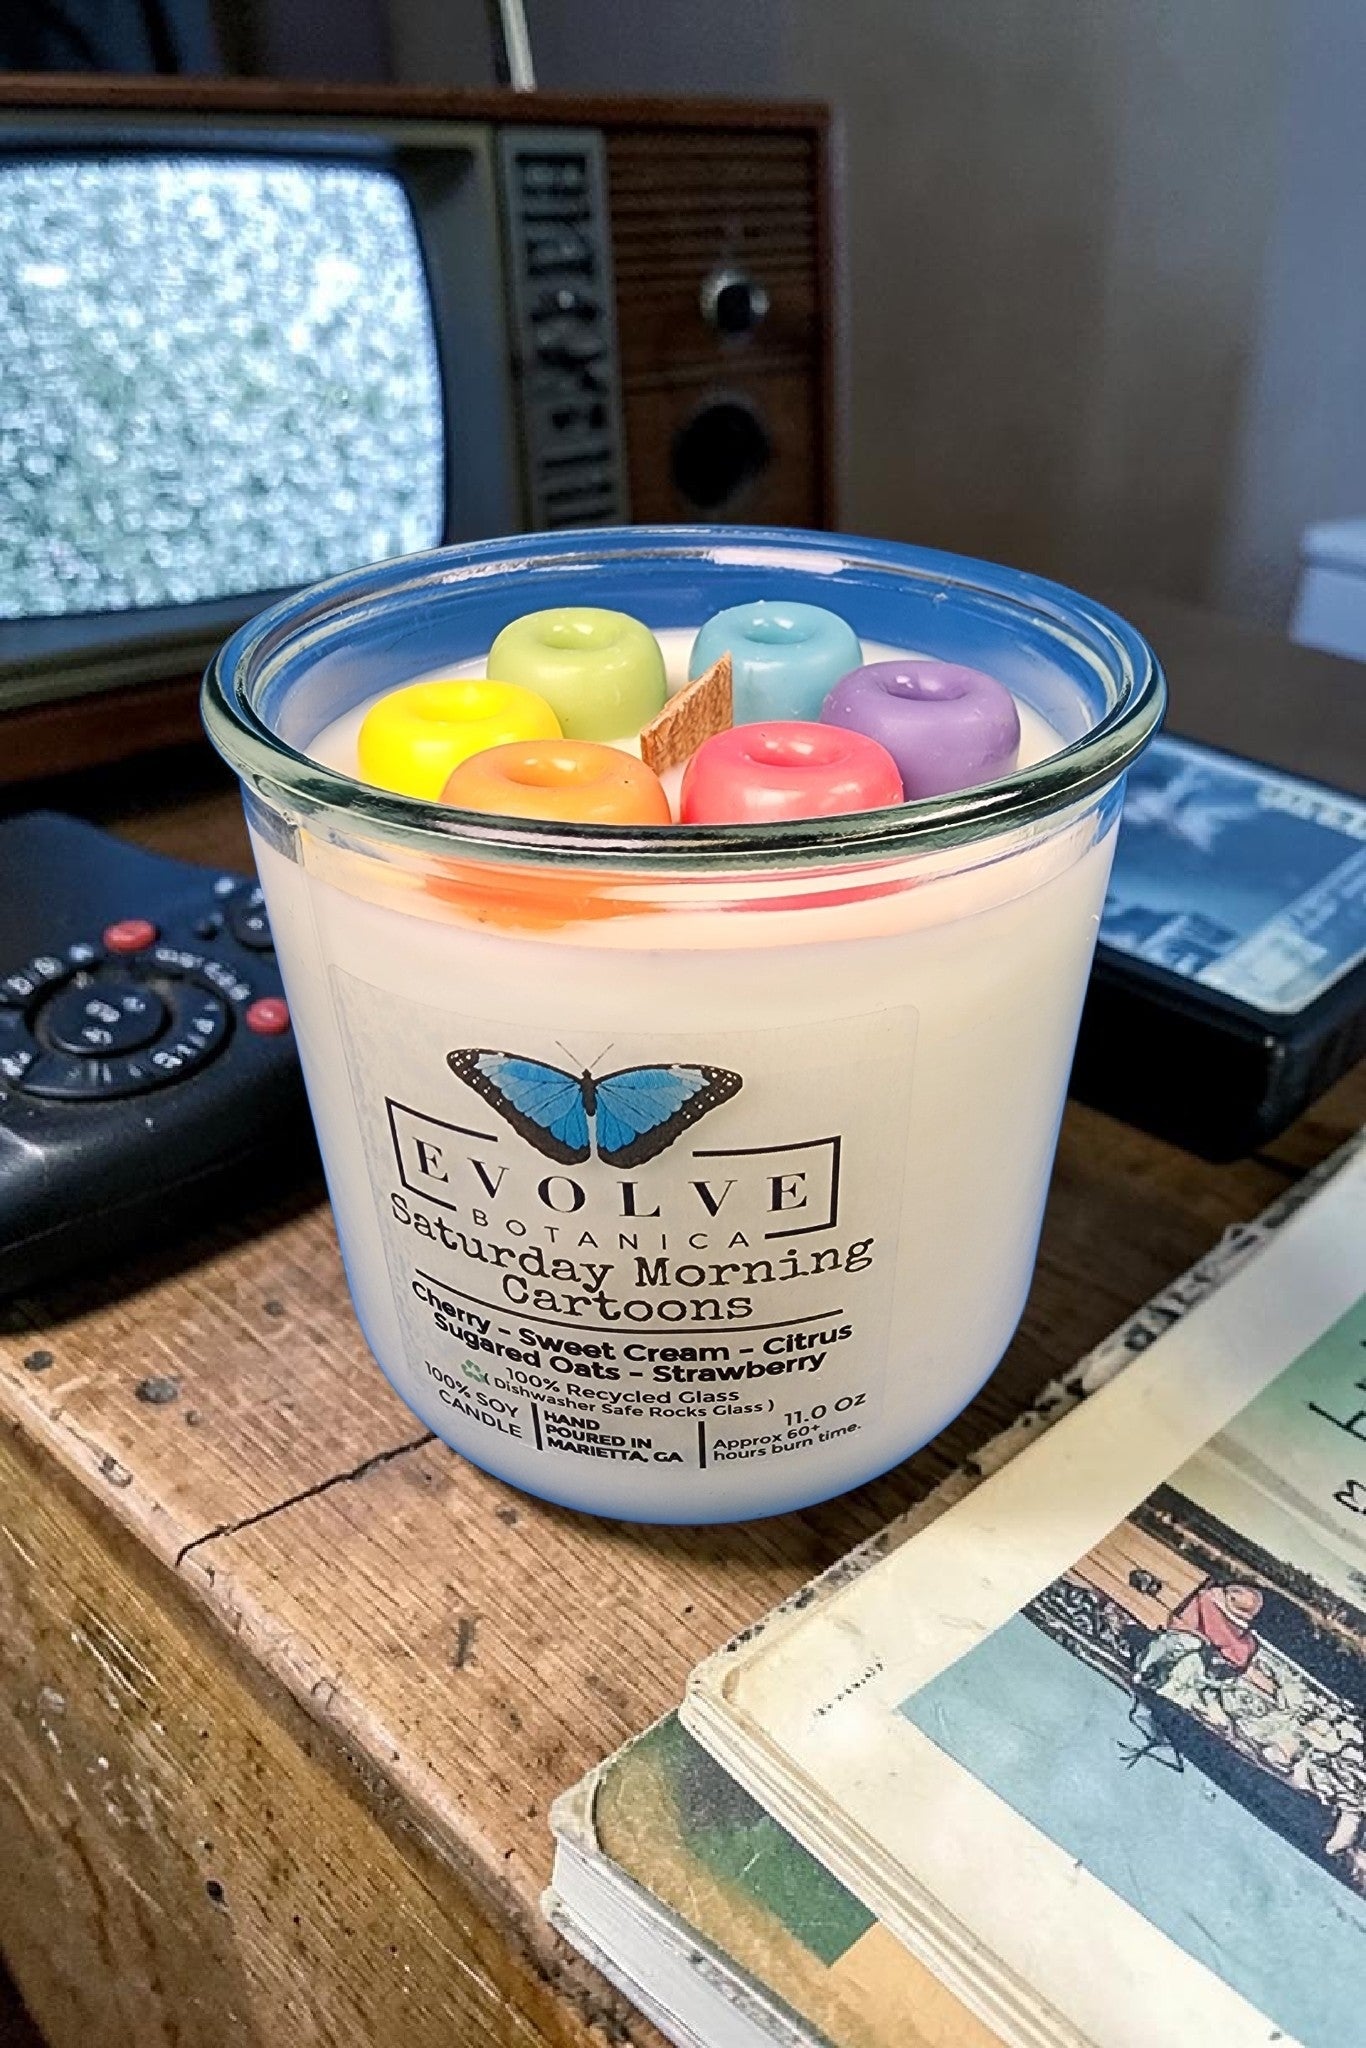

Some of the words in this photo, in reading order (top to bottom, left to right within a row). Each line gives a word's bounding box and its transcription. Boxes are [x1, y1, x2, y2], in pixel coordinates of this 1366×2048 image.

[412, 1136, 808, 1218] EVOLVE
[390, 1192, 615, 1294] Saturday
[633, 1237, 875, 1288] Morning
[472, 1208, 750, 1250] BOTANICA
[502, 1274, 753, 1322] Cartoons
[411, 1281, 491, 1335] Cherry
[518, 1327, 617, 1361] Sweet
[623, 1343, 730, 1363] Cream
[762, 1324, 853, 1355] Citrus
[433, 1312, 541, 1368] Sugared
[549, 1355, 621, 1381] Oats
[652, 1351, 828, 1383] Strawberry
[424, 1360, 472, 1399] 100%
[476, 1391, 519, 1418] SOY
[494, 1377, 596, 1412] Dishwasher
[601, 1403, 644, 1417] Safe
[649, 1406, 707, 1418] Rocks
[712, 1403, 763, 1416] Glass
[505, 1366, 560, 1393] 100%
[566, 1383, 671, 1404] Recycled
[678, 1390, 740, 1404] Glass
[438, 1389, 523, 1439] CANDLE
[543, 1409, 601, 1431] HAND
[784, 1404, 828, 1427] 11.0
[545, 1423, 626, 1448] POURED
[630, 1437, 652, 1449] IN
[712, 1433, 783, 1451] Approx
[787, 1424, 821, 1440] 60+
[713, 1448, 768, 1461] hours
[771, 1437, 814, 1454] burn
[818, 1422, 863, 1443] time.
[653, 1451, 684, 1463] GA
